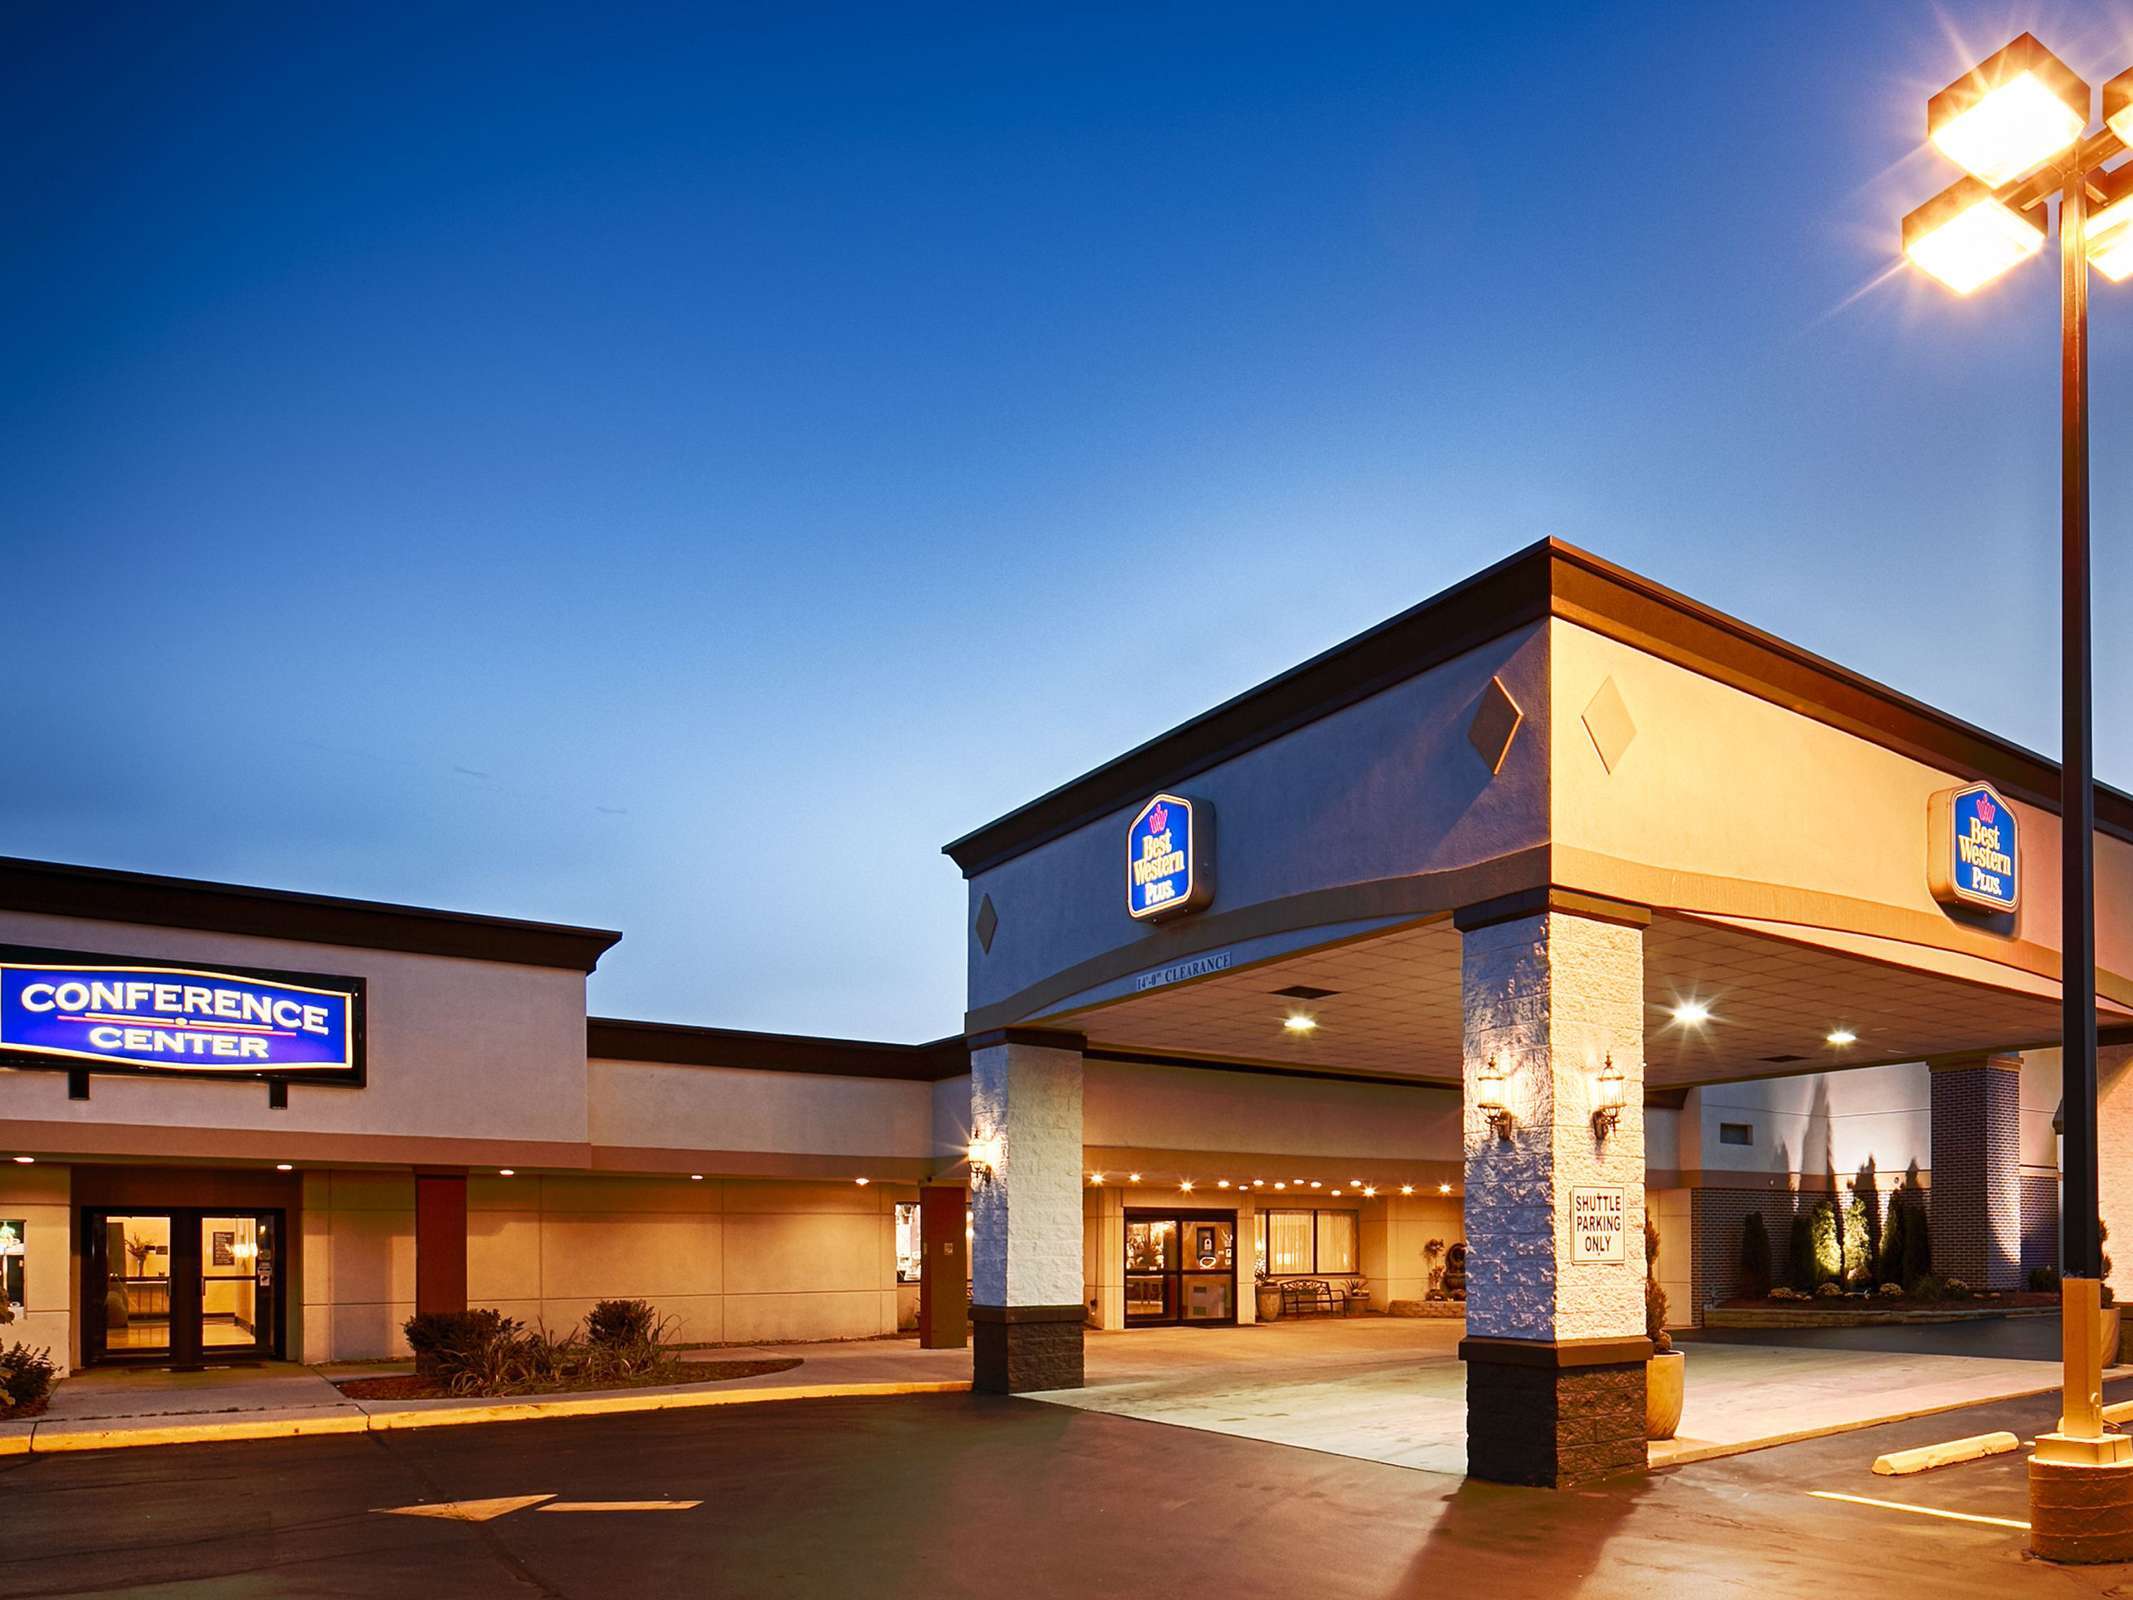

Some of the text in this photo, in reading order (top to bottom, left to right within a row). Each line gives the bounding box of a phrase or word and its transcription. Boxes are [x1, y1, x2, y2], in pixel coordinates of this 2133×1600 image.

[1142, 828, 1172, 860] Best
[1970, 816, 2000, 850] Best
[1133, 850, 1185, 886] Western
[1959, 834, 2011, 876] Western
[1164, 954, 1229, 983] CLEARANCE
[21, 981, 329, 1036] CONFERENCE
[89, 1026, 269, 1059] CENTER
[1576, 1195, 1621, 1212] SHUTTLE
[1576, 1215, 1621, 1232] PARKING
[1585, 1235, 1612, 1252] ONLY
